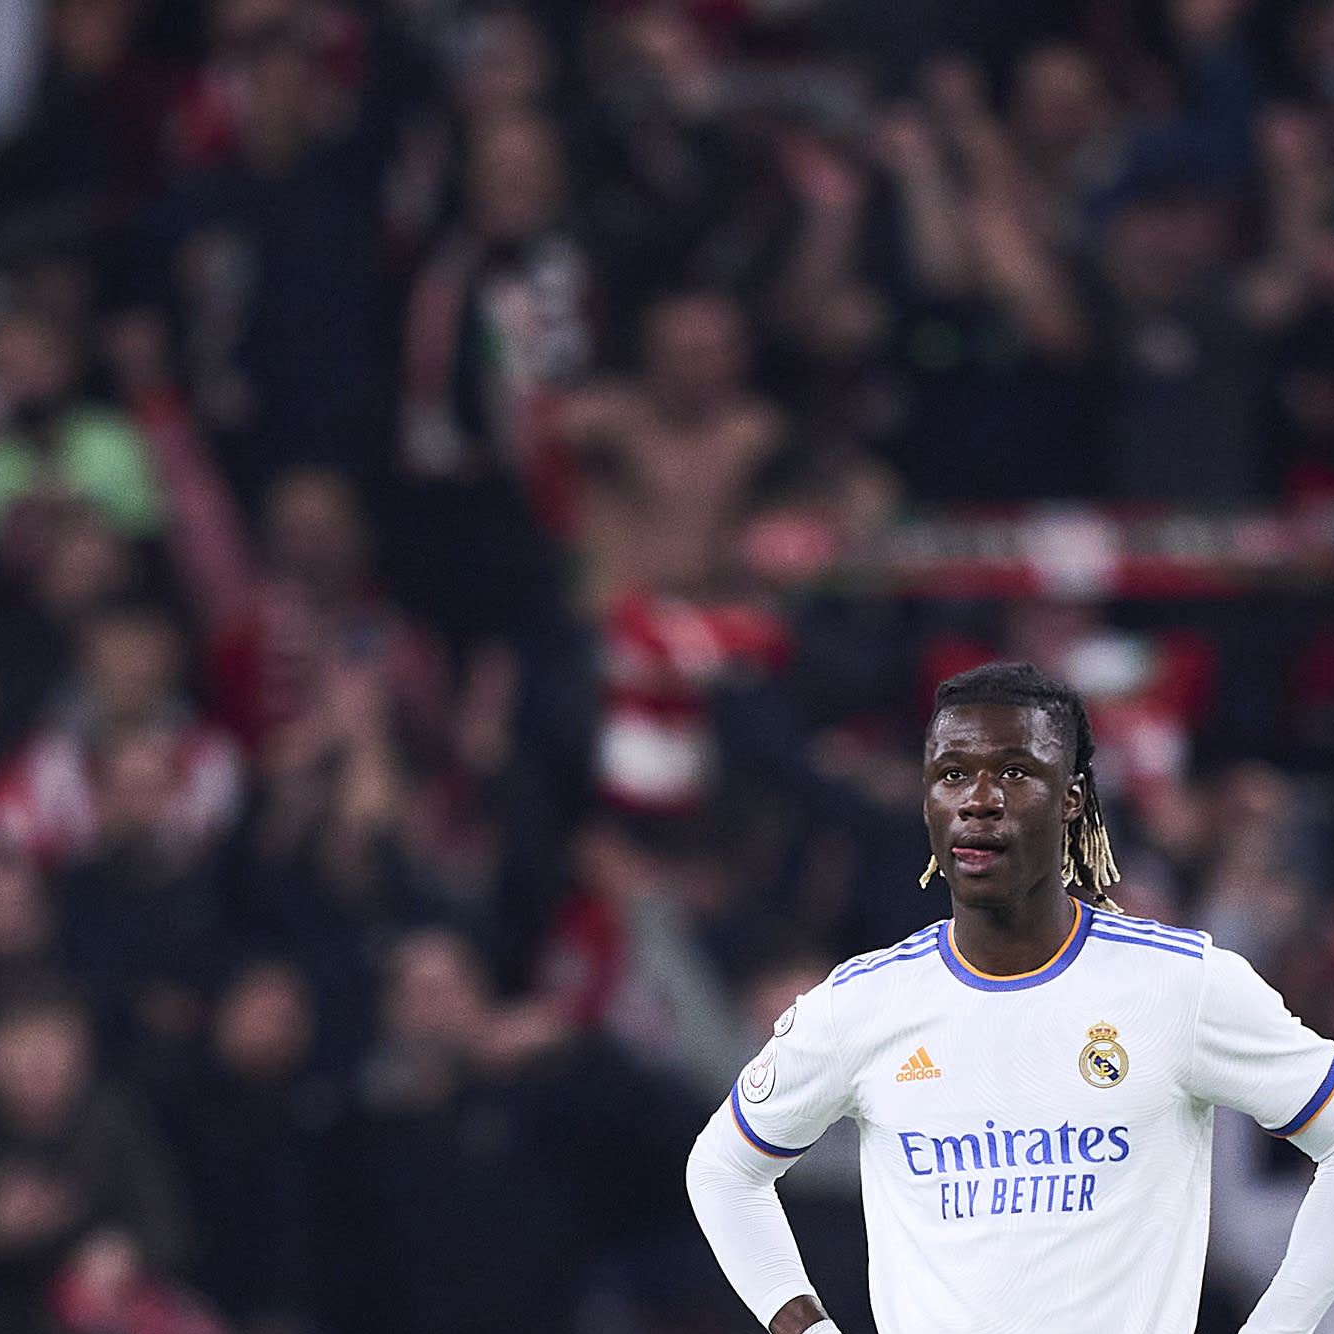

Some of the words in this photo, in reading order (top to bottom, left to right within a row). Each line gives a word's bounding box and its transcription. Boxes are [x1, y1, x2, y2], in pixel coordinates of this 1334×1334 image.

[895, 1066, 942, 1082] adidas
[898, 1119, 1130, 1176] Emirates
[941, 1180, 979, 1220] FLY
[990, 1174, 1096, 1216] BETTER
